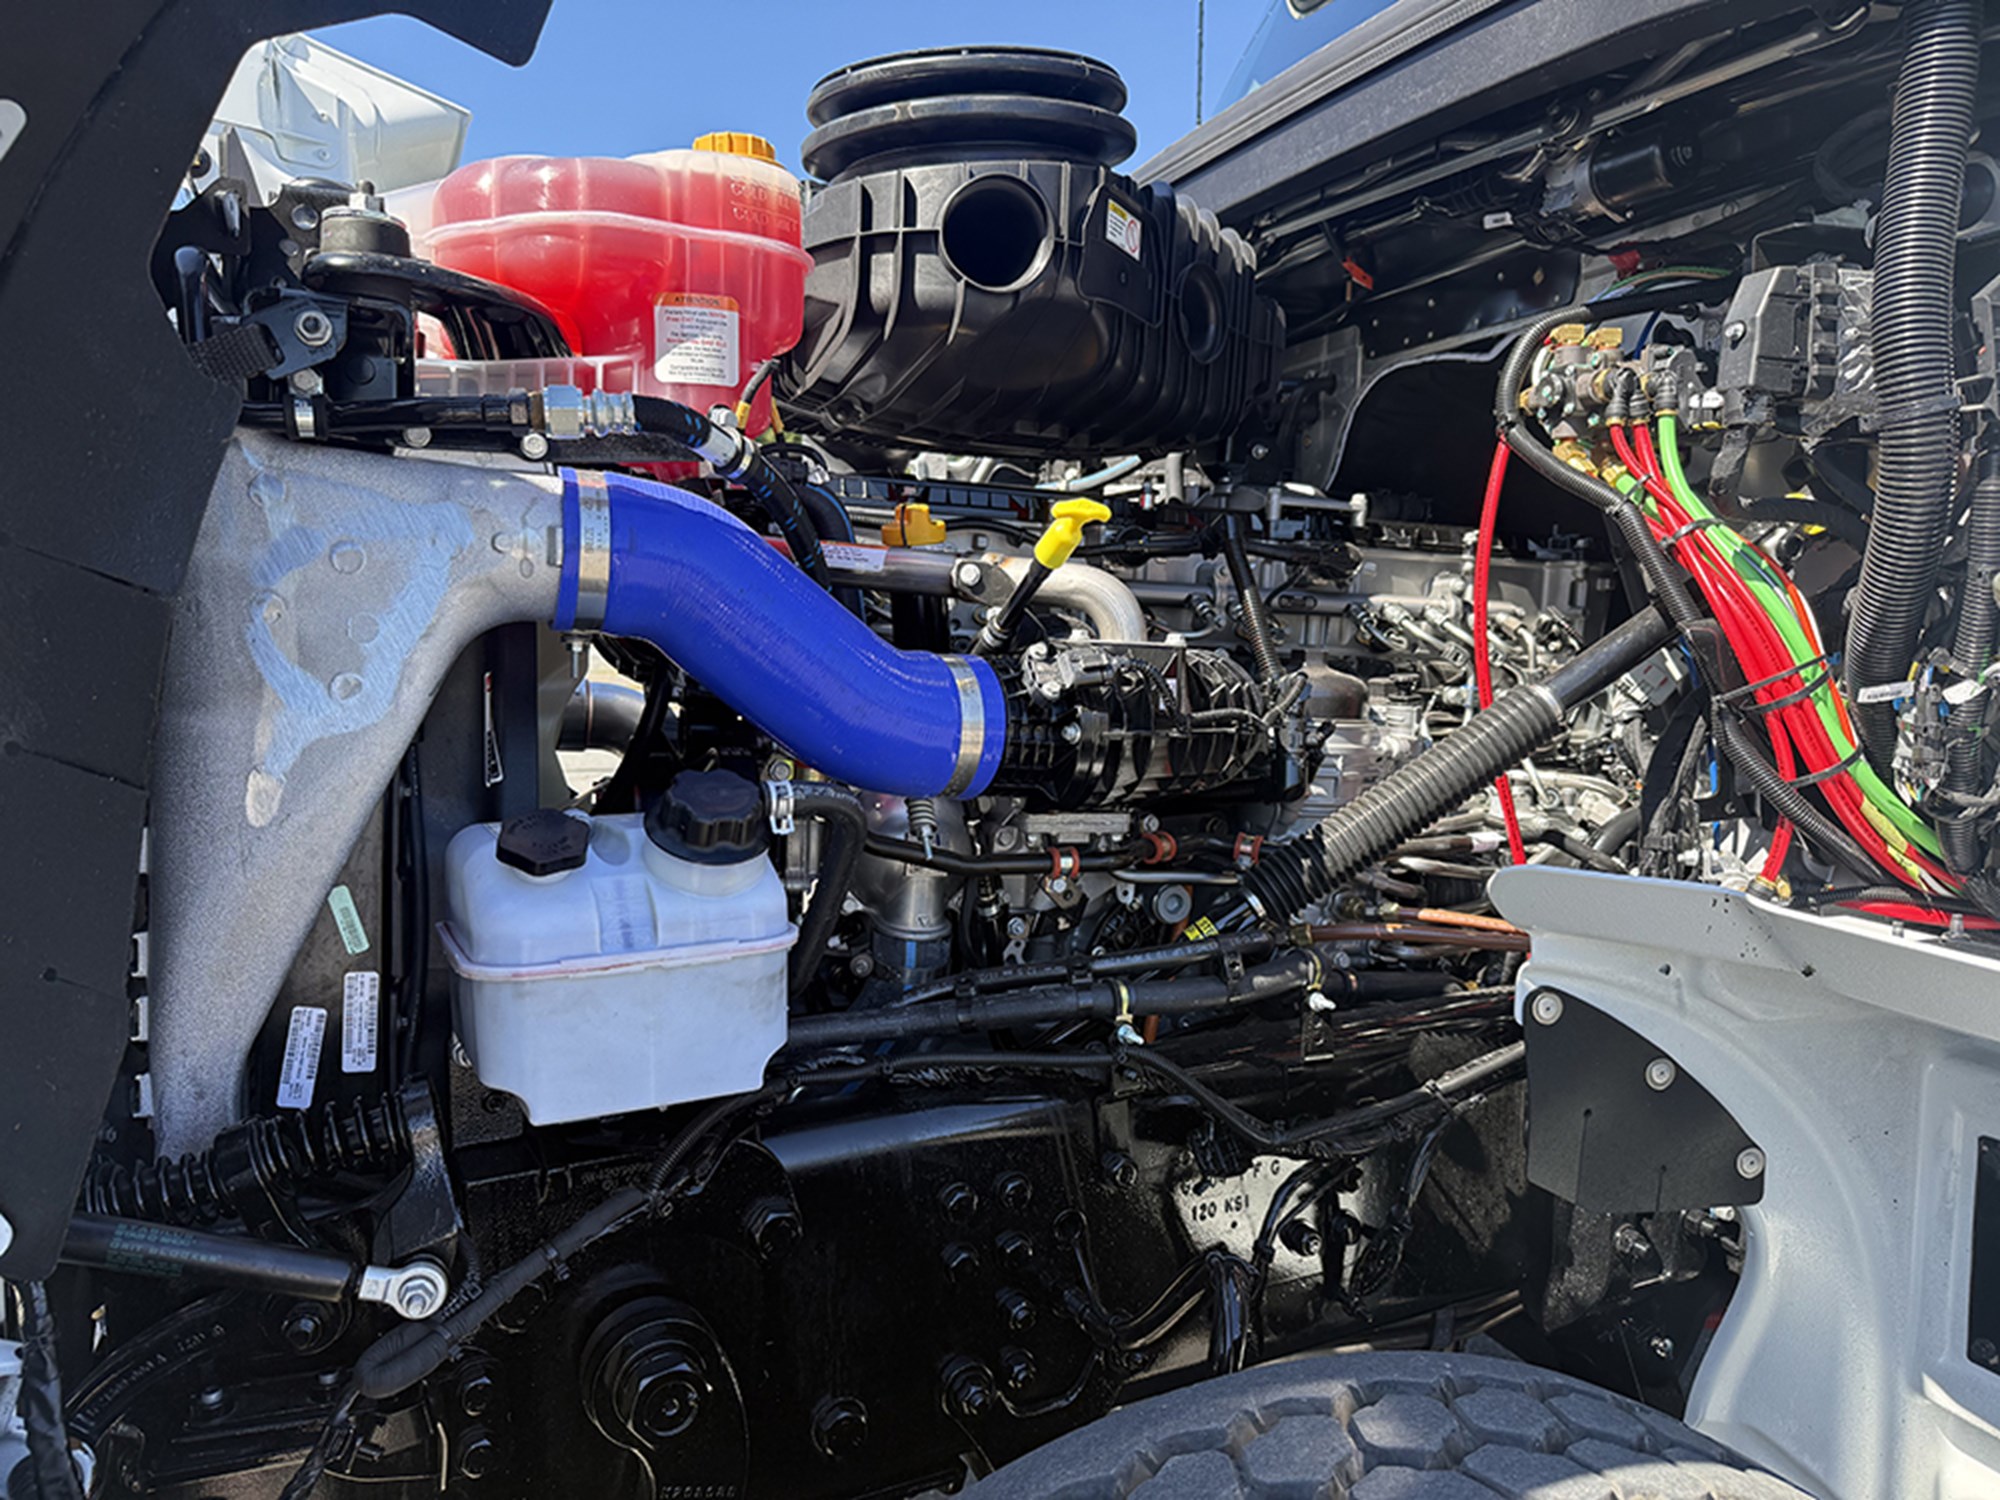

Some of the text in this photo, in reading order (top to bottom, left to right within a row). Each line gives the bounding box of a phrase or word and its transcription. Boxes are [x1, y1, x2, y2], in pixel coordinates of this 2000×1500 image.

[674, 296, 720, 306] ATTENTION
[1191, 1194, 1249, 1222] 120 KSI
